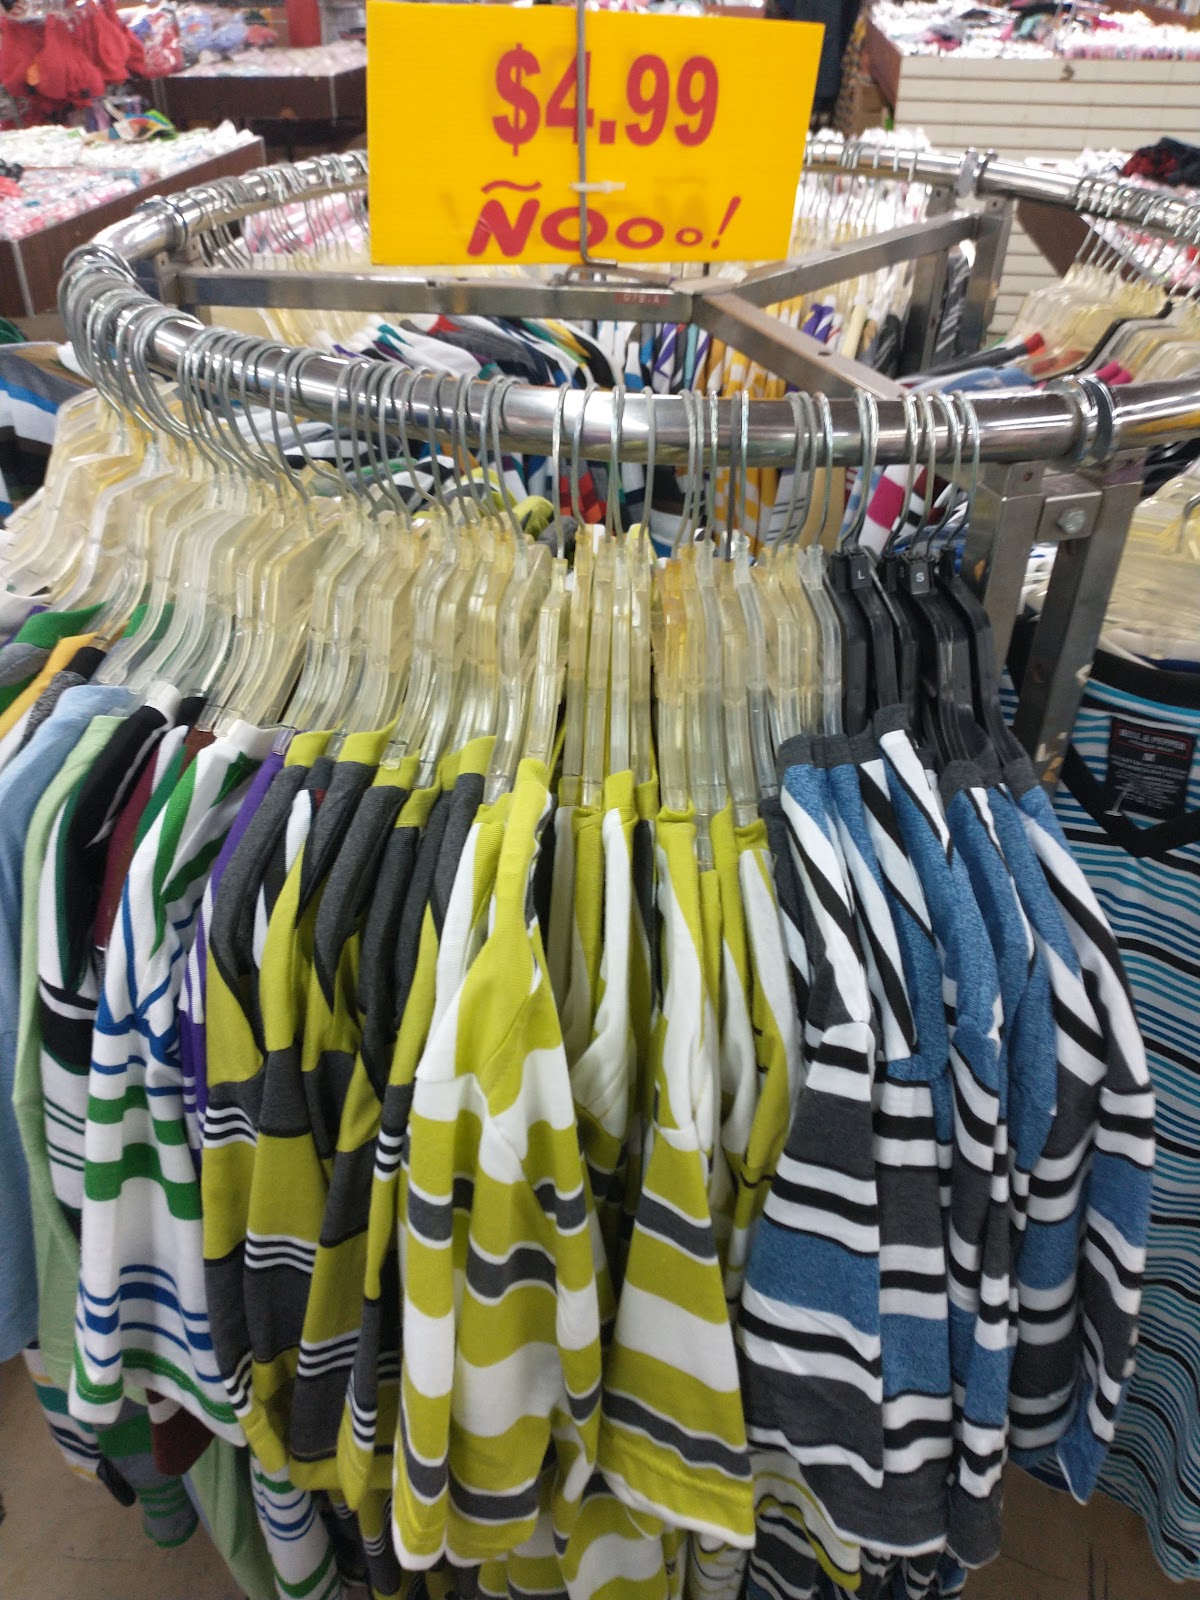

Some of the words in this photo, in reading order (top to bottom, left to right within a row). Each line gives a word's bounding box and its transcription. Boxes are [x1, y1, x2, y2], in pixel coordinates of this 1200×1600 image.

[492, 42, 719, 157] $4.99
[857, 569, 866, 580] L
[915, 571, 925, 582] S
